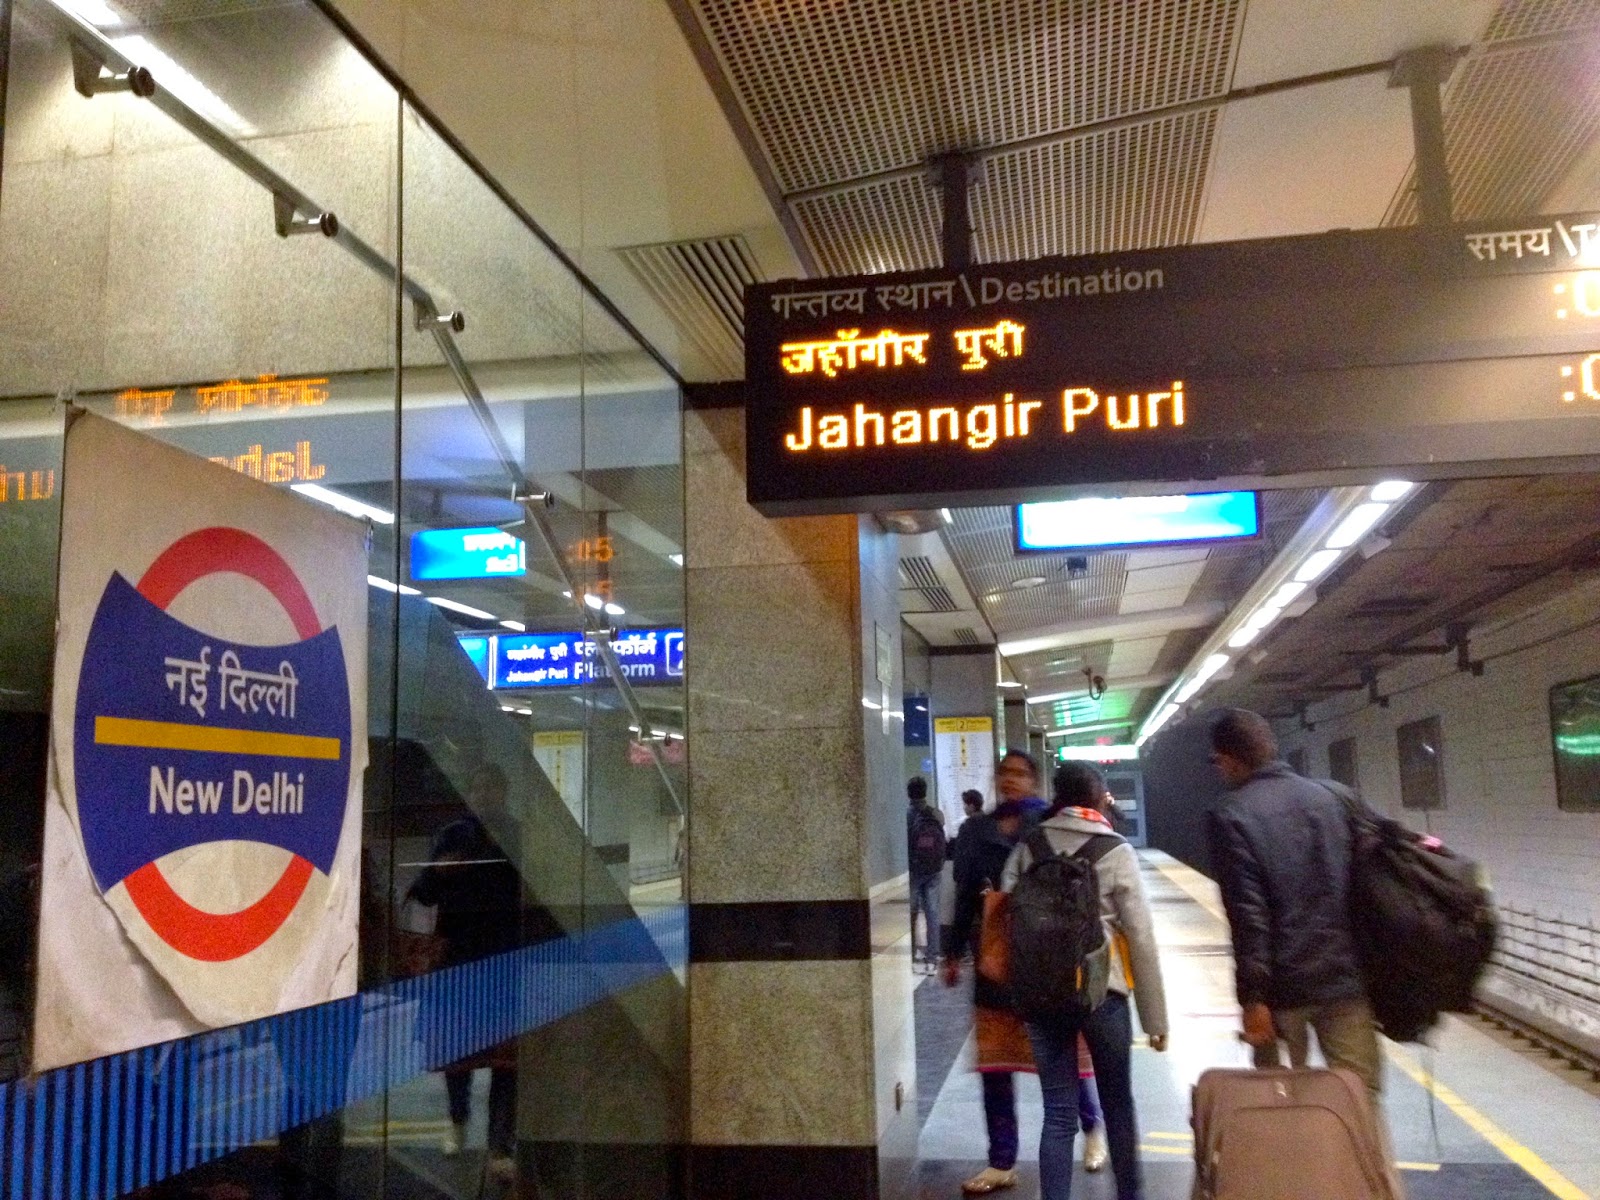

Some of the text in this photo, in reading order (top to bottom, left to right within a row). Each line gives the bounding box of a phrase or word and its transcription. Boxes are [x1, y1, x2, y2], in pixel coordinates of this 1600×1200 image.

[785, 380, 1187, 452] Jahangir Puri
[164, 645, 298, 718] नई दिल्ली
[149, 766, 304, 815] New Delhi
